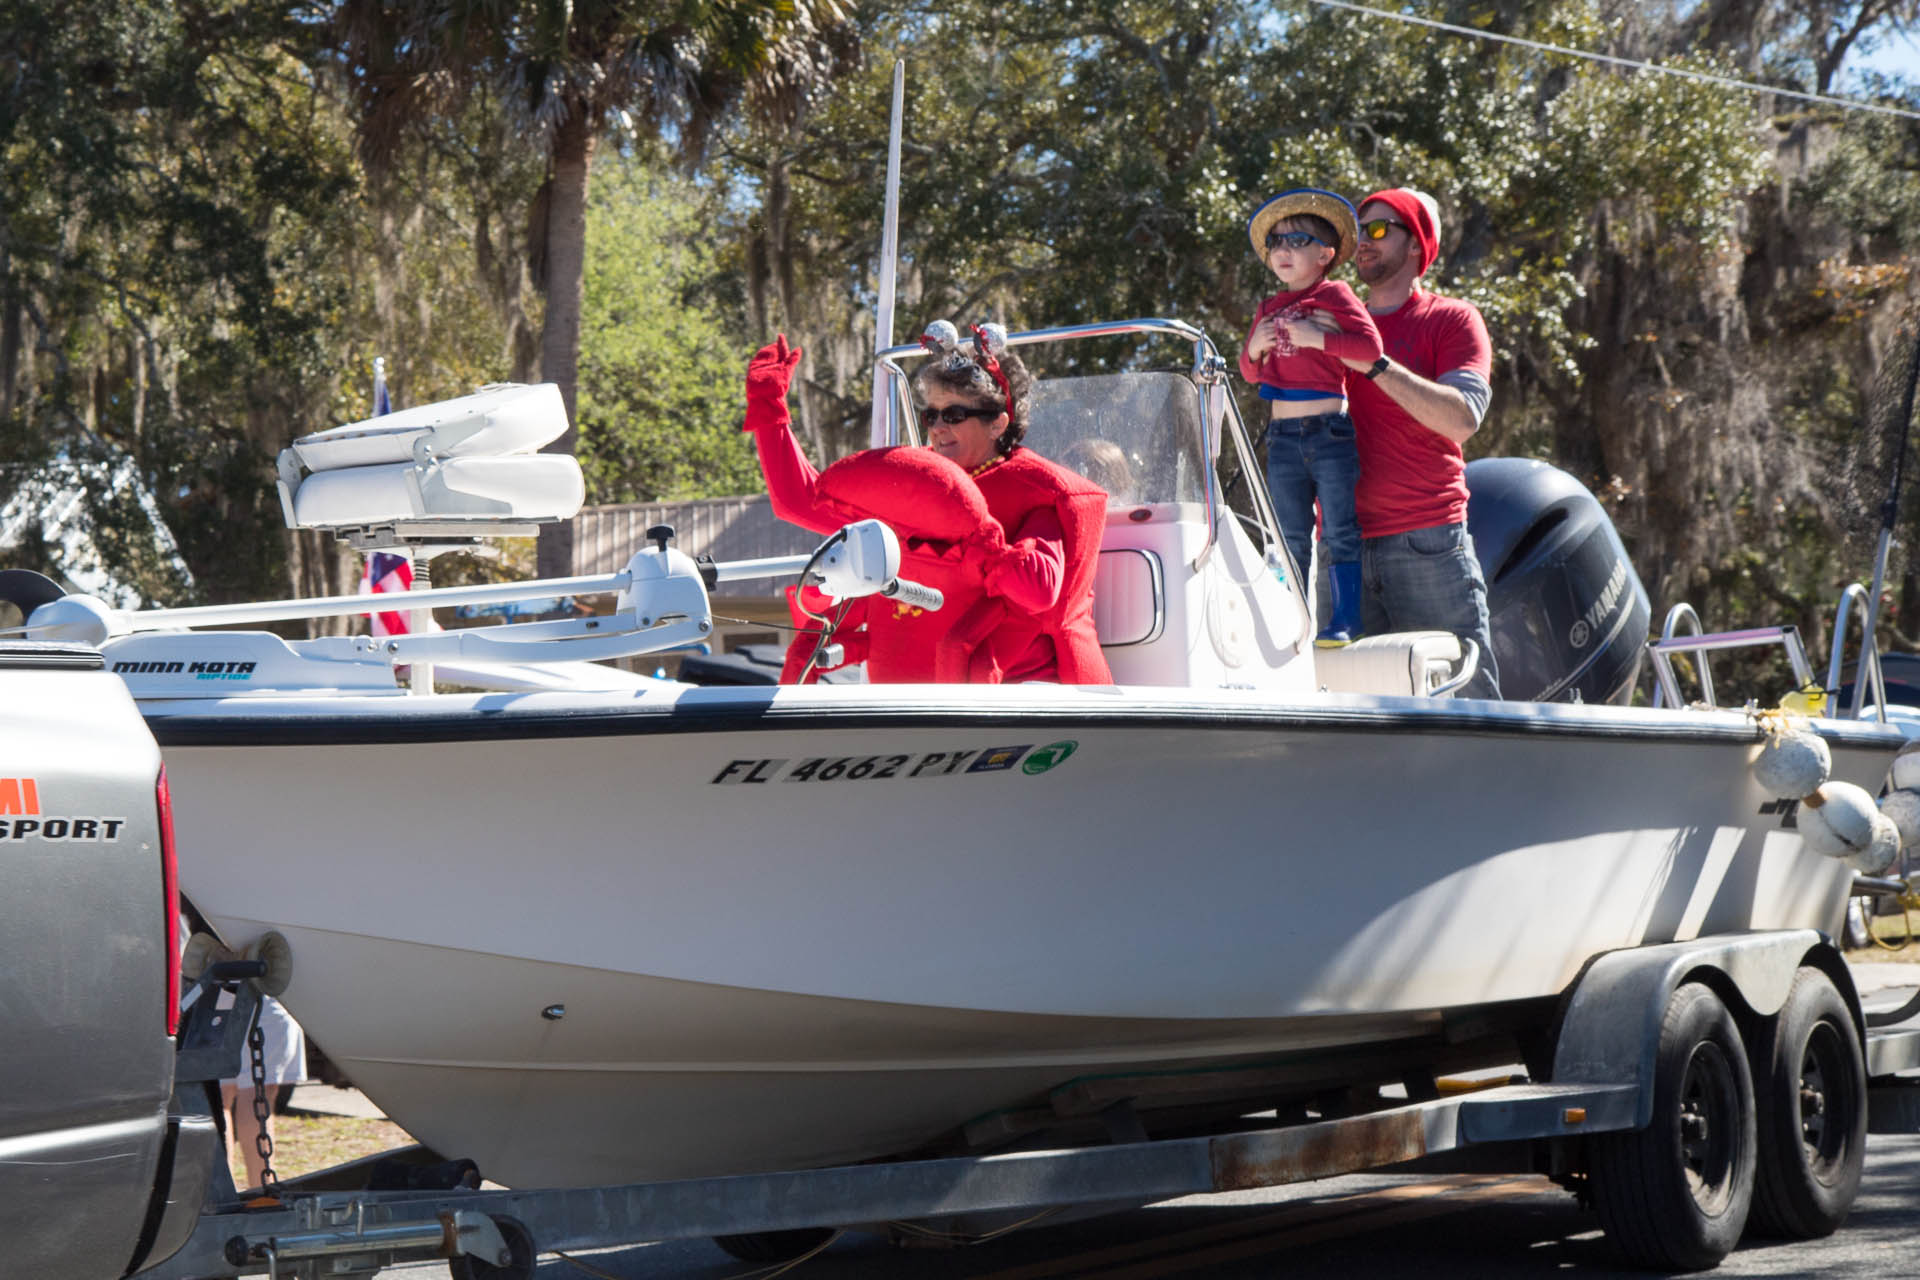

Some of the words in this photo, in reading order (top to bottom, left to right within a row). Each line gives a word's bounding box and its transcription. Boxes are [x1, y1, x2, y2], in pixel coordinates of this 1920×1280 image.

[188, 661, 256, 673] KOTA
[711, 759, 770, 784] FL
[790, 754, 909, 782] 4662
[909, 750, 977, 777] PY
